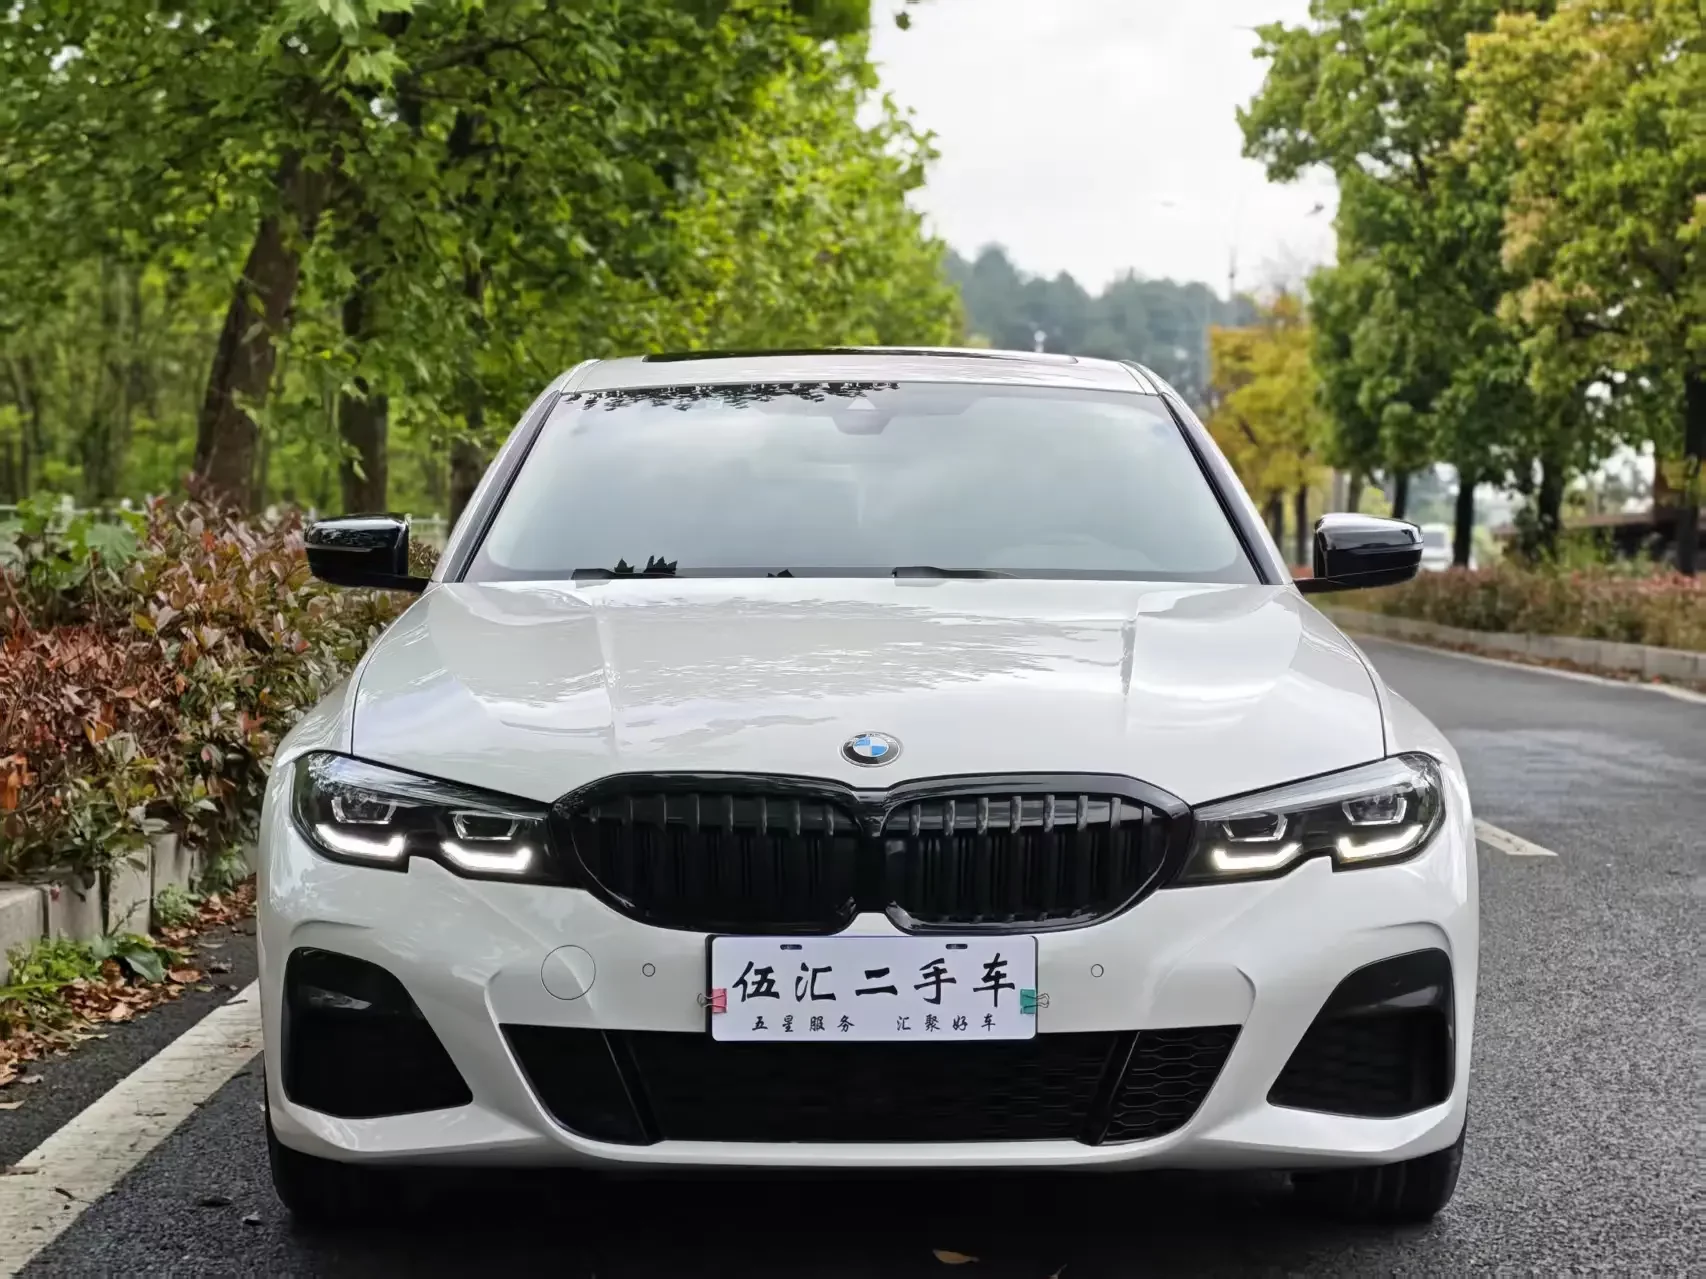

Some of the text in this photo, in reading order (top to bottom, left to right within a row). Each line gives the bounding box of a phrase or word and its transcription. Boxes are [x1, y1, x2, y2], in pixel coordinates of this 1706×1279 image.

[732, 953, 1015, 1007] 伍汇二手车
[752, 1013, 995, 1032] 五星服务 汇聚好车
